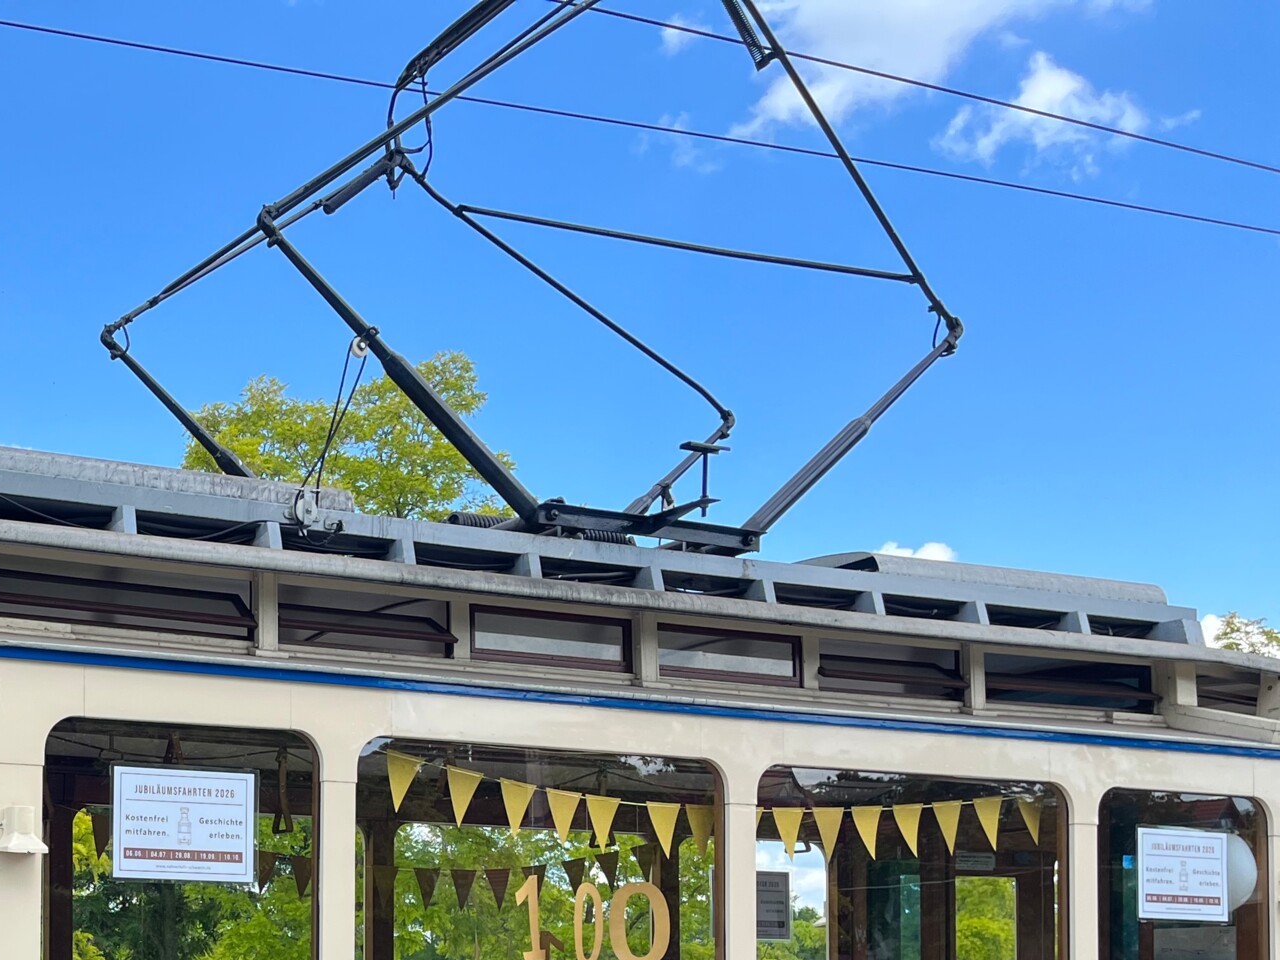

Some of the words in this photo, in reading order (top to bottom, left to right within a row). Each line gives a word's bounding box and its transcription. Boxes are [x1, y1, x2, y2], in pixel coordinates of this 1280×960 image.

[134, 783, 213, 798] JUBILÄUMSFAHRTEN
[215, 789, 236, 799] 2026
[125, 814, 169, 823] Kostenfrei
[199, 817, 244, 827] Geschichte
[125, 828, 170, 837] mitfahren.
[209, 832, 243, 841] erleben.
